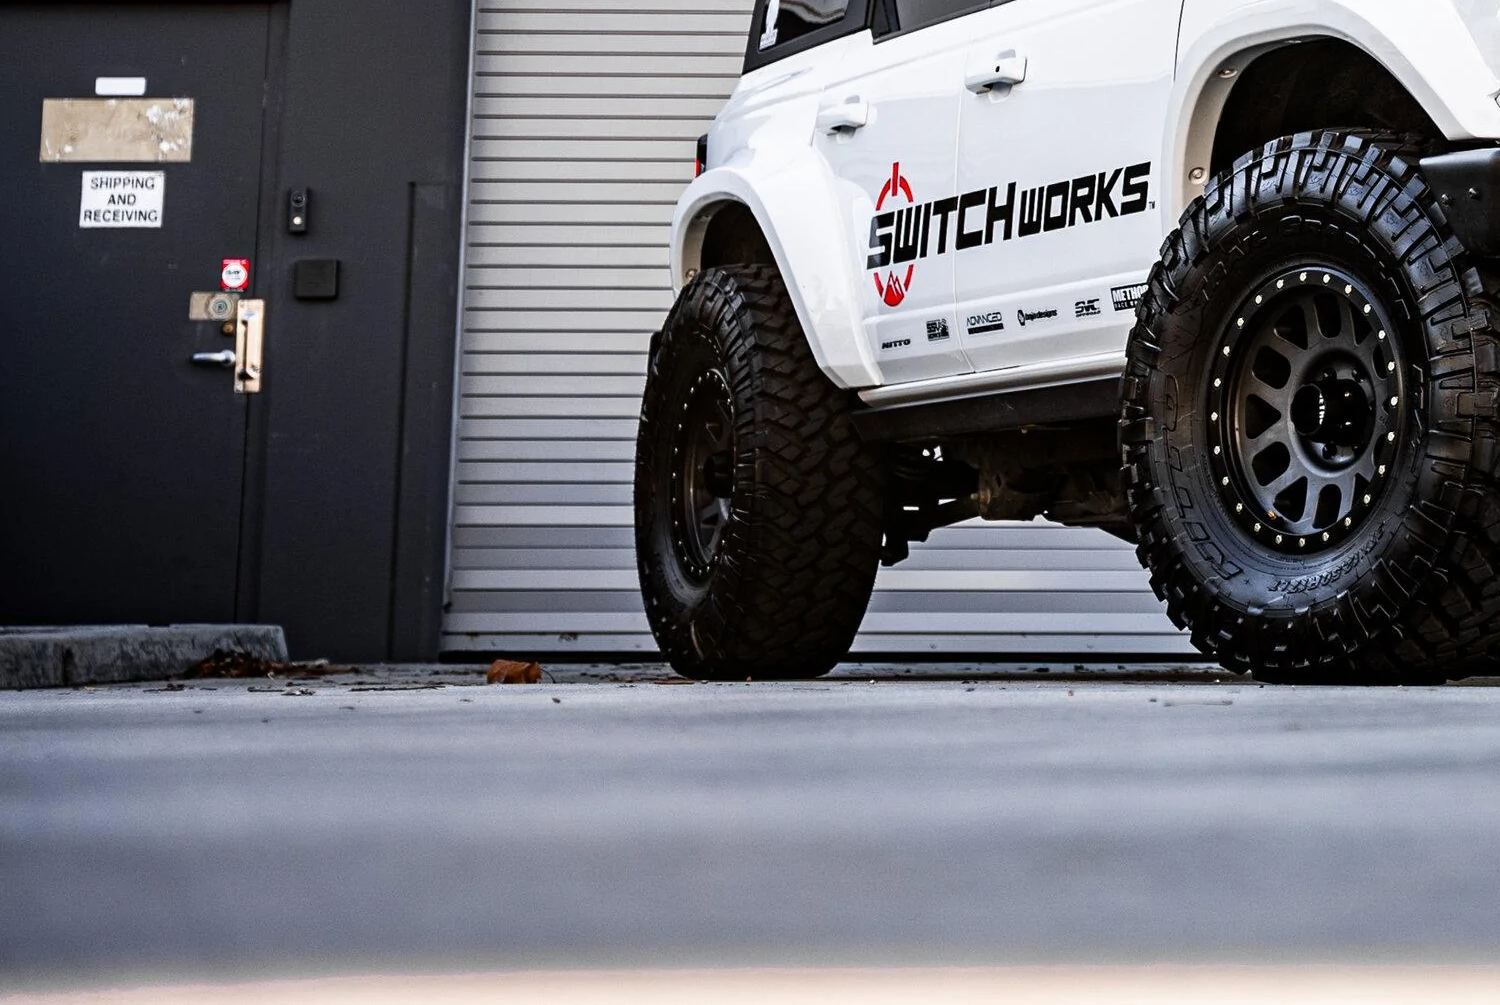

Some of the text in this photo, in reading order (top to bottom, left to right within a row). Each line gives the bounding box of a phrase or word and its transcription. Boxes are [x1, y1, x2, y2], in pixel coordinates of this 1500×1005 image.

[90, 177, 156, 190] SHIPPING
[107, 193, 137, 206] AND
[83, 209, 159, 223] RECEIVING
[881, 338, 911, 350] NITTO
